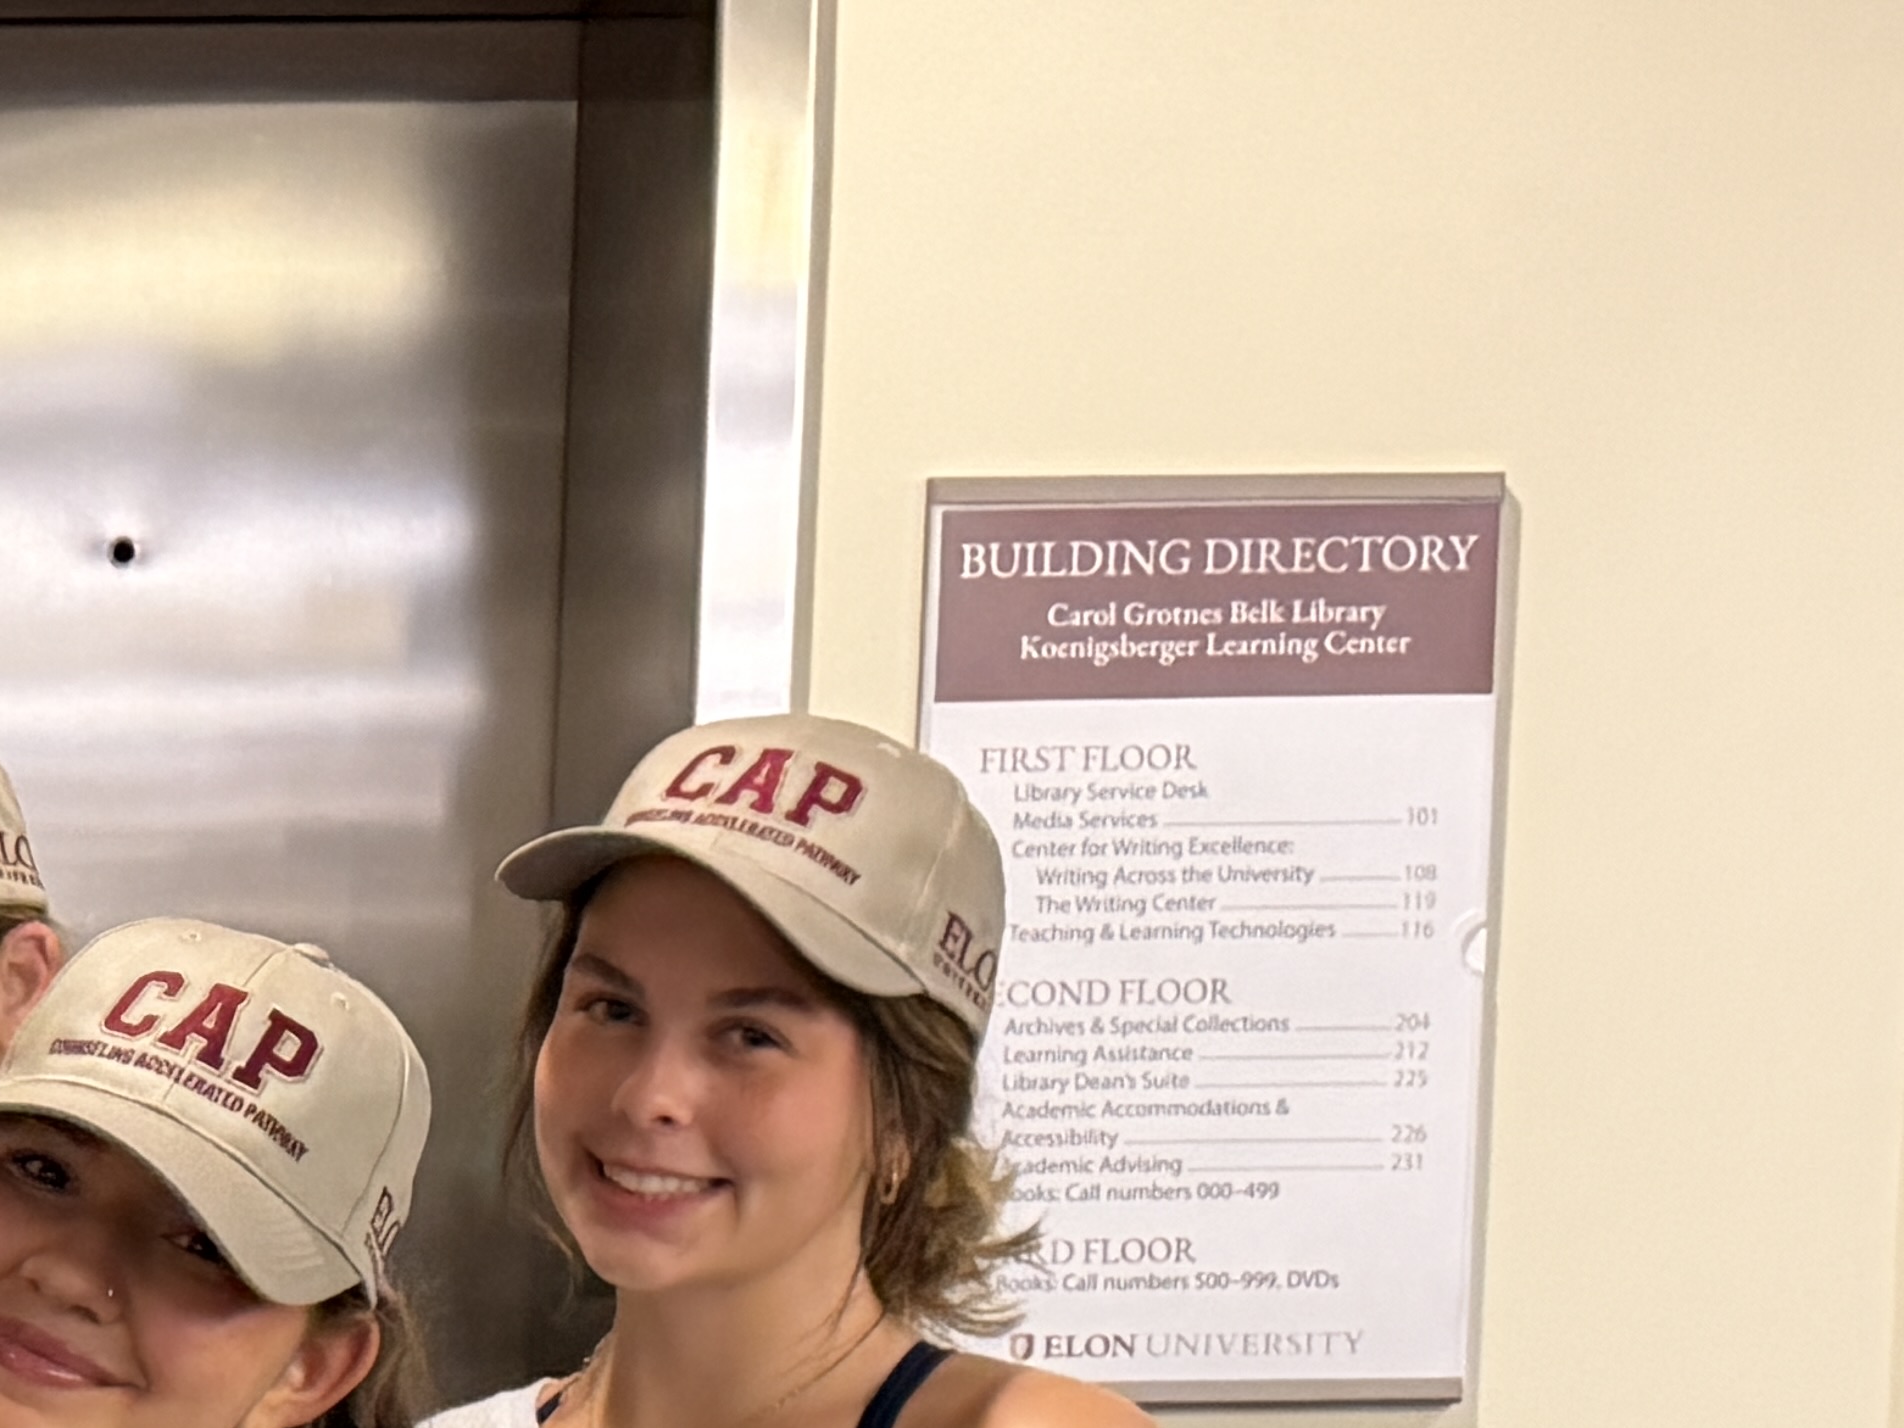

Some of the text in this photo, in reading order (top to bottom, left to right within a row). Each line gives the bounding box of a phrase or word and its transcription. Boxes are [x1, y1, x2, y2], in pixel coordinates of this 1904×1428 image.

[960, 535, 1480, 578] BUILDING DIRECTORY
[1048, 597, 1388, 631] Carol Grotnes Belk Library
[1020, 630, 1411, 666] Koenigsberger Learning Center
[980, 743, 1198, 773] FIRST FLOOR
[662, 744, 865, 828] CAP
[1014, 780, 1208, 805] Library Service Desk
[1013, 806, 1438, 829] Media Services 101
[1011, 836, 1294, 860] Center for Writing Excellence:
[1036, 866, 1108, 889] Writing
[1113, 865, 1176, 885] Across
[1182, 864, 1213, 883] the
[1218, 864, 1315, 886] University
[1036, 895, 1070, 914] The
[1074, 894, 1146, 917] Writing
[1152, 892, 1217, 912] Center
[1009, 924, 1095, 945] Teaching
[1099, 923, 1114, 941] &
[1119, 922, 1204, 944] Learning
[1209, 920, 1336, 944] Technologies
[1118, 977, 1232, 1006] FLOOR
[102, 970, 319, 1090] CAP
[1004, 1017, 1085, 1036] Archives
[1090, 1016, 1105, 1035] &
[1109, 1014, 1178, 1038] Special
[1183, 1013, 1290, 1033] Collections
[1003, 1046, 1088, 1067] Learning
[1092, 1045, 1193, 1062] Assistance
[1002, 1073, 1069, 1095] Library
[1075, 1071, 1136, 1090] Dean's
[1142, 1070, 1190, 1090] Suite
[1002, 1097, 1290, 1119] Academic Accommodations &
[1000, 1128, 1118, 1150] Accessibility
[1099, 1155, 1183, 1177] Advising
[1010, 1184, 1061, 1202] ooks:
[1065, 1182, 1101, 1202] Call
[1106, 1180, 1192, 1201] numbers
[1083, 1237, 1196, 1264] FLOOR
[1062, 1272, 1098, 1291] Call
[1103, 1271, 1190, 1290] numbers
[1286, 1268, 1340, 1289] DVDs
[1044, 1329, 1365, 1358] ELON UNIVERSITY
